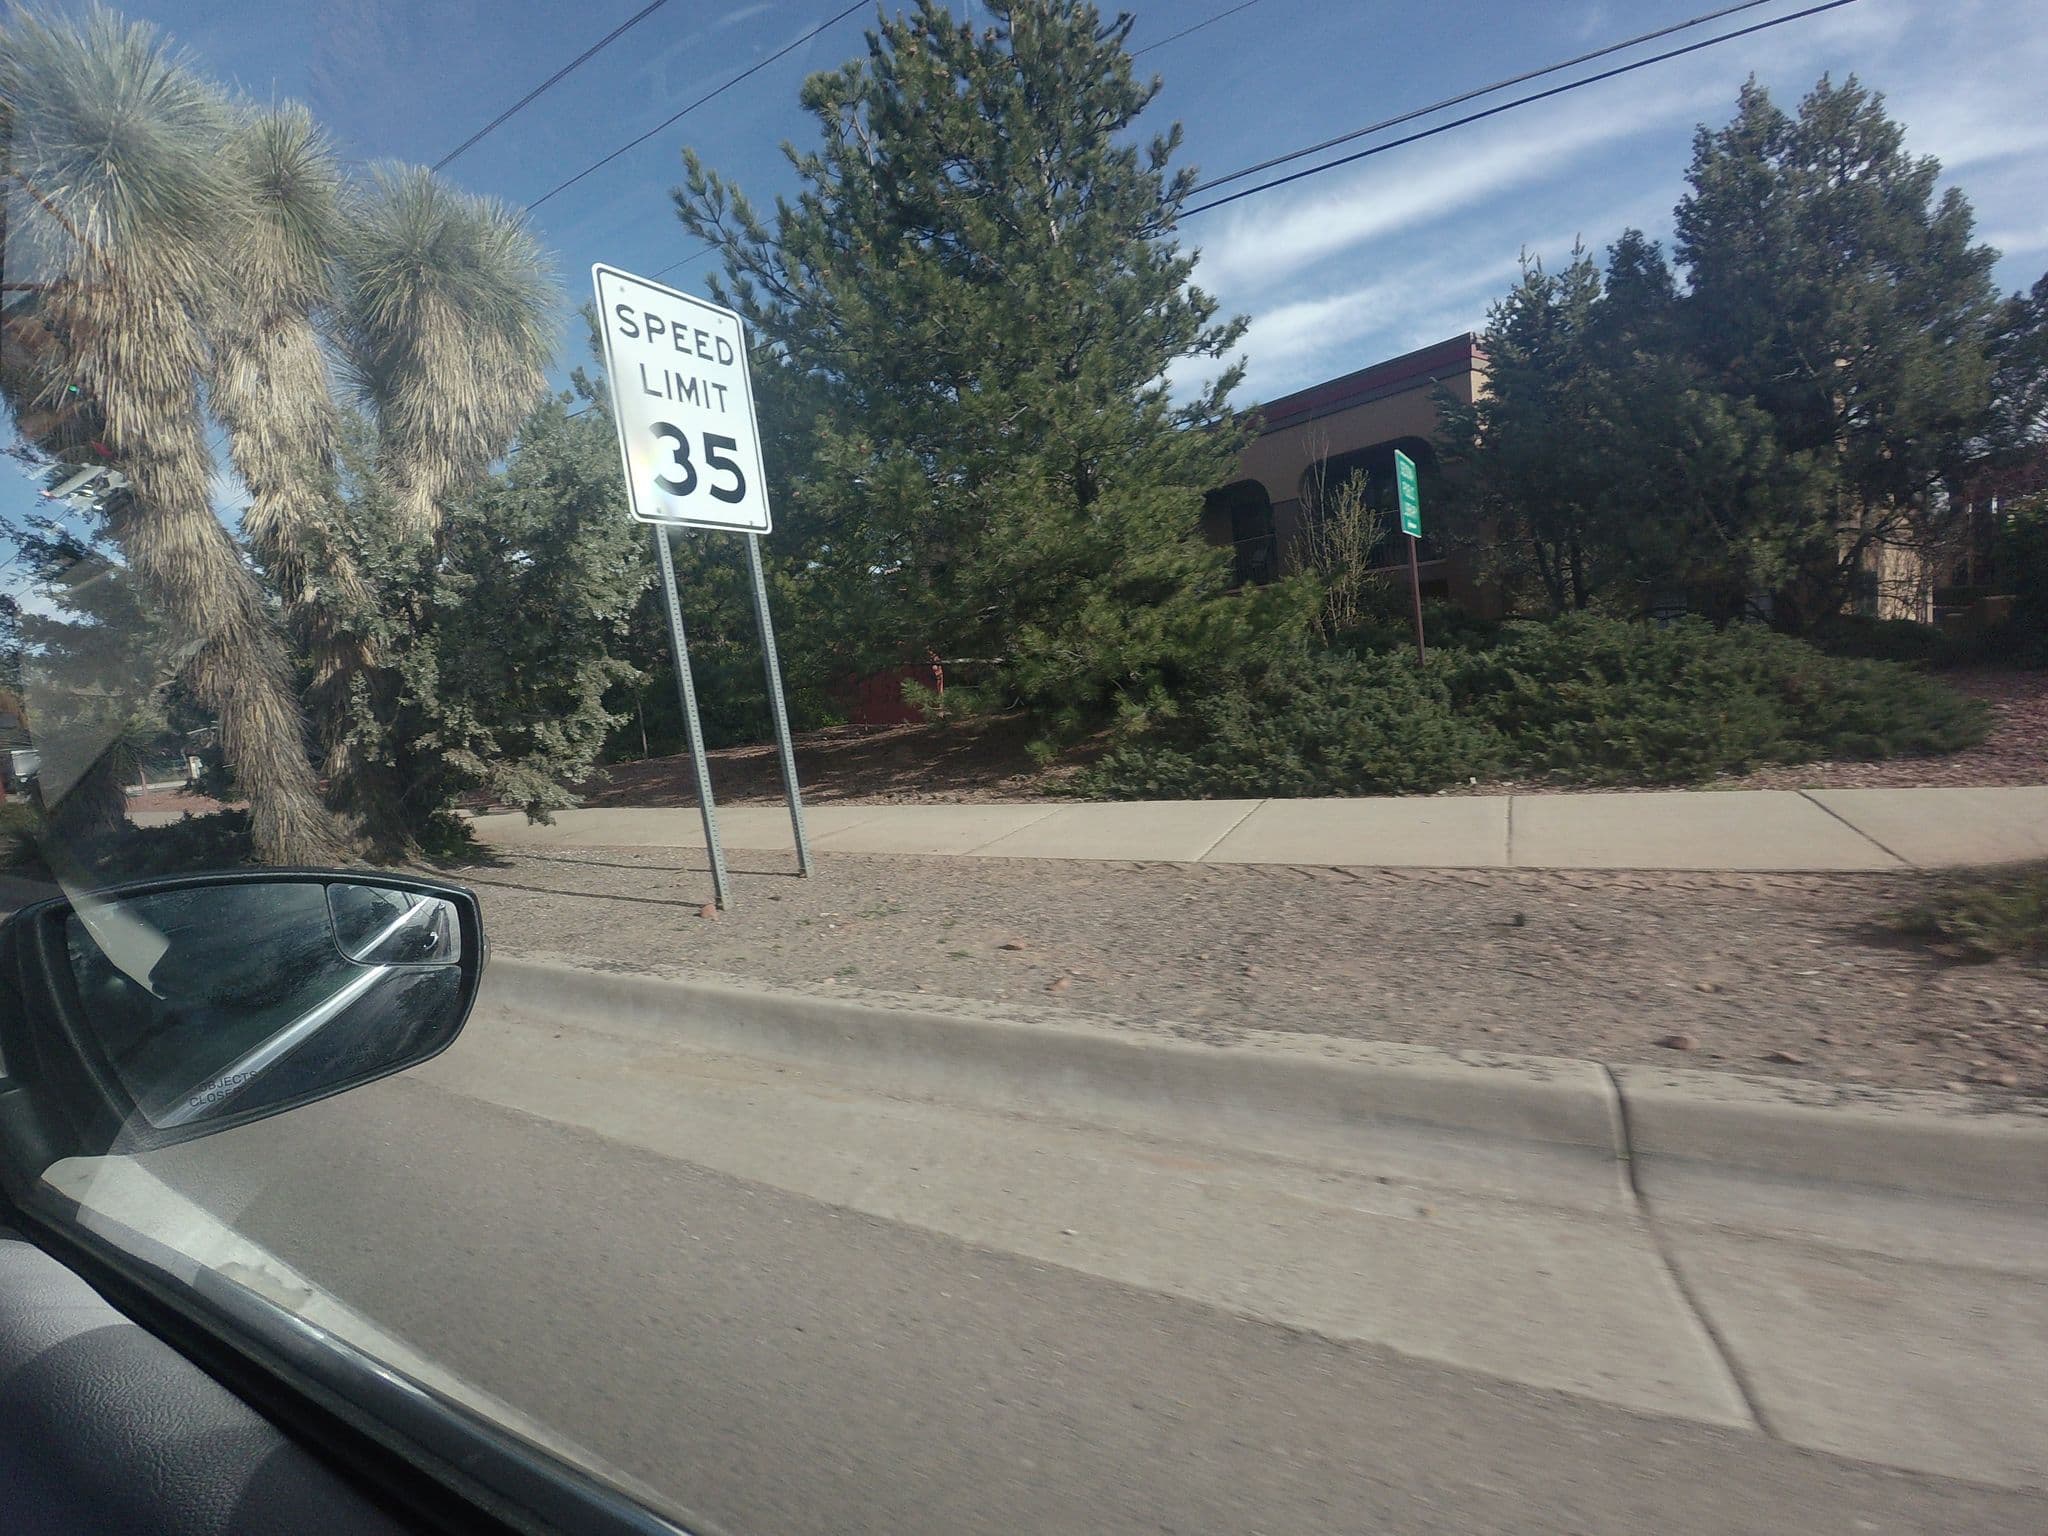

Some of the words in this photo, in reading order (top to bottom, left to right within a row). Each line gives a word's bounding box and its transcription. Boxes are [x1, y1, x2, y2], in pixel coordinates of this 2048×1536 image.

[616, 304, 734, 366] SPEED
[640, 363, 728, 413] LIMIT
[650, 421, 746, 504] 35
[199, 1070, 258, 1092] OBJECTS
